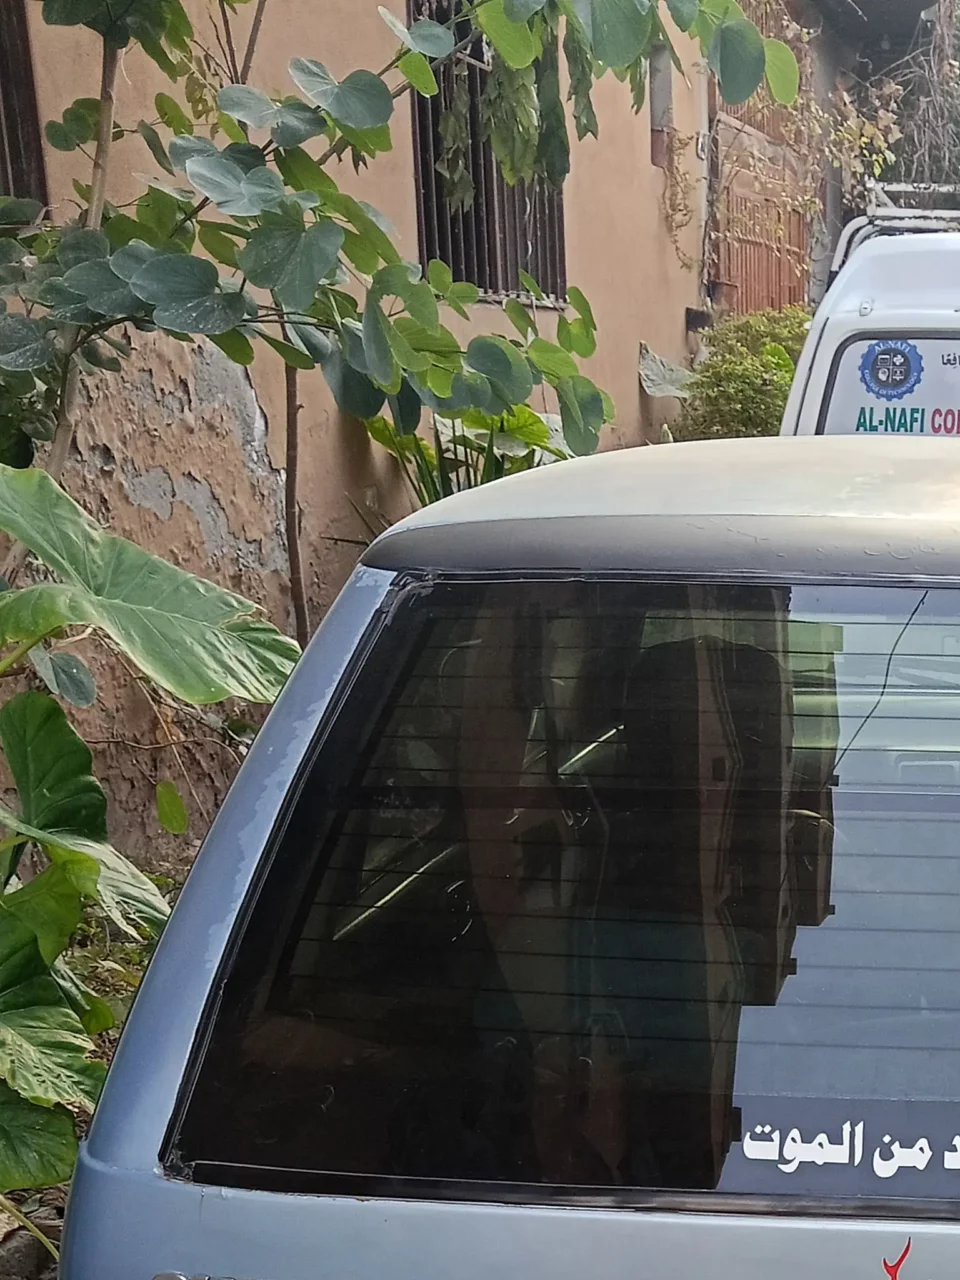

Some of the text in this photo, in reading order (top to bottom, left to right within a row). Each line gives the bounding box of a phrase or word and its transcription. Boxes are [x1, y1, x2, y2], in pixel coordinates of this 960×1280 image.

[855, 406, 926, 433] AL-NAFI
[742, 1120, 864, 1173] الموت
[872, 1133, 933, 1178] من
